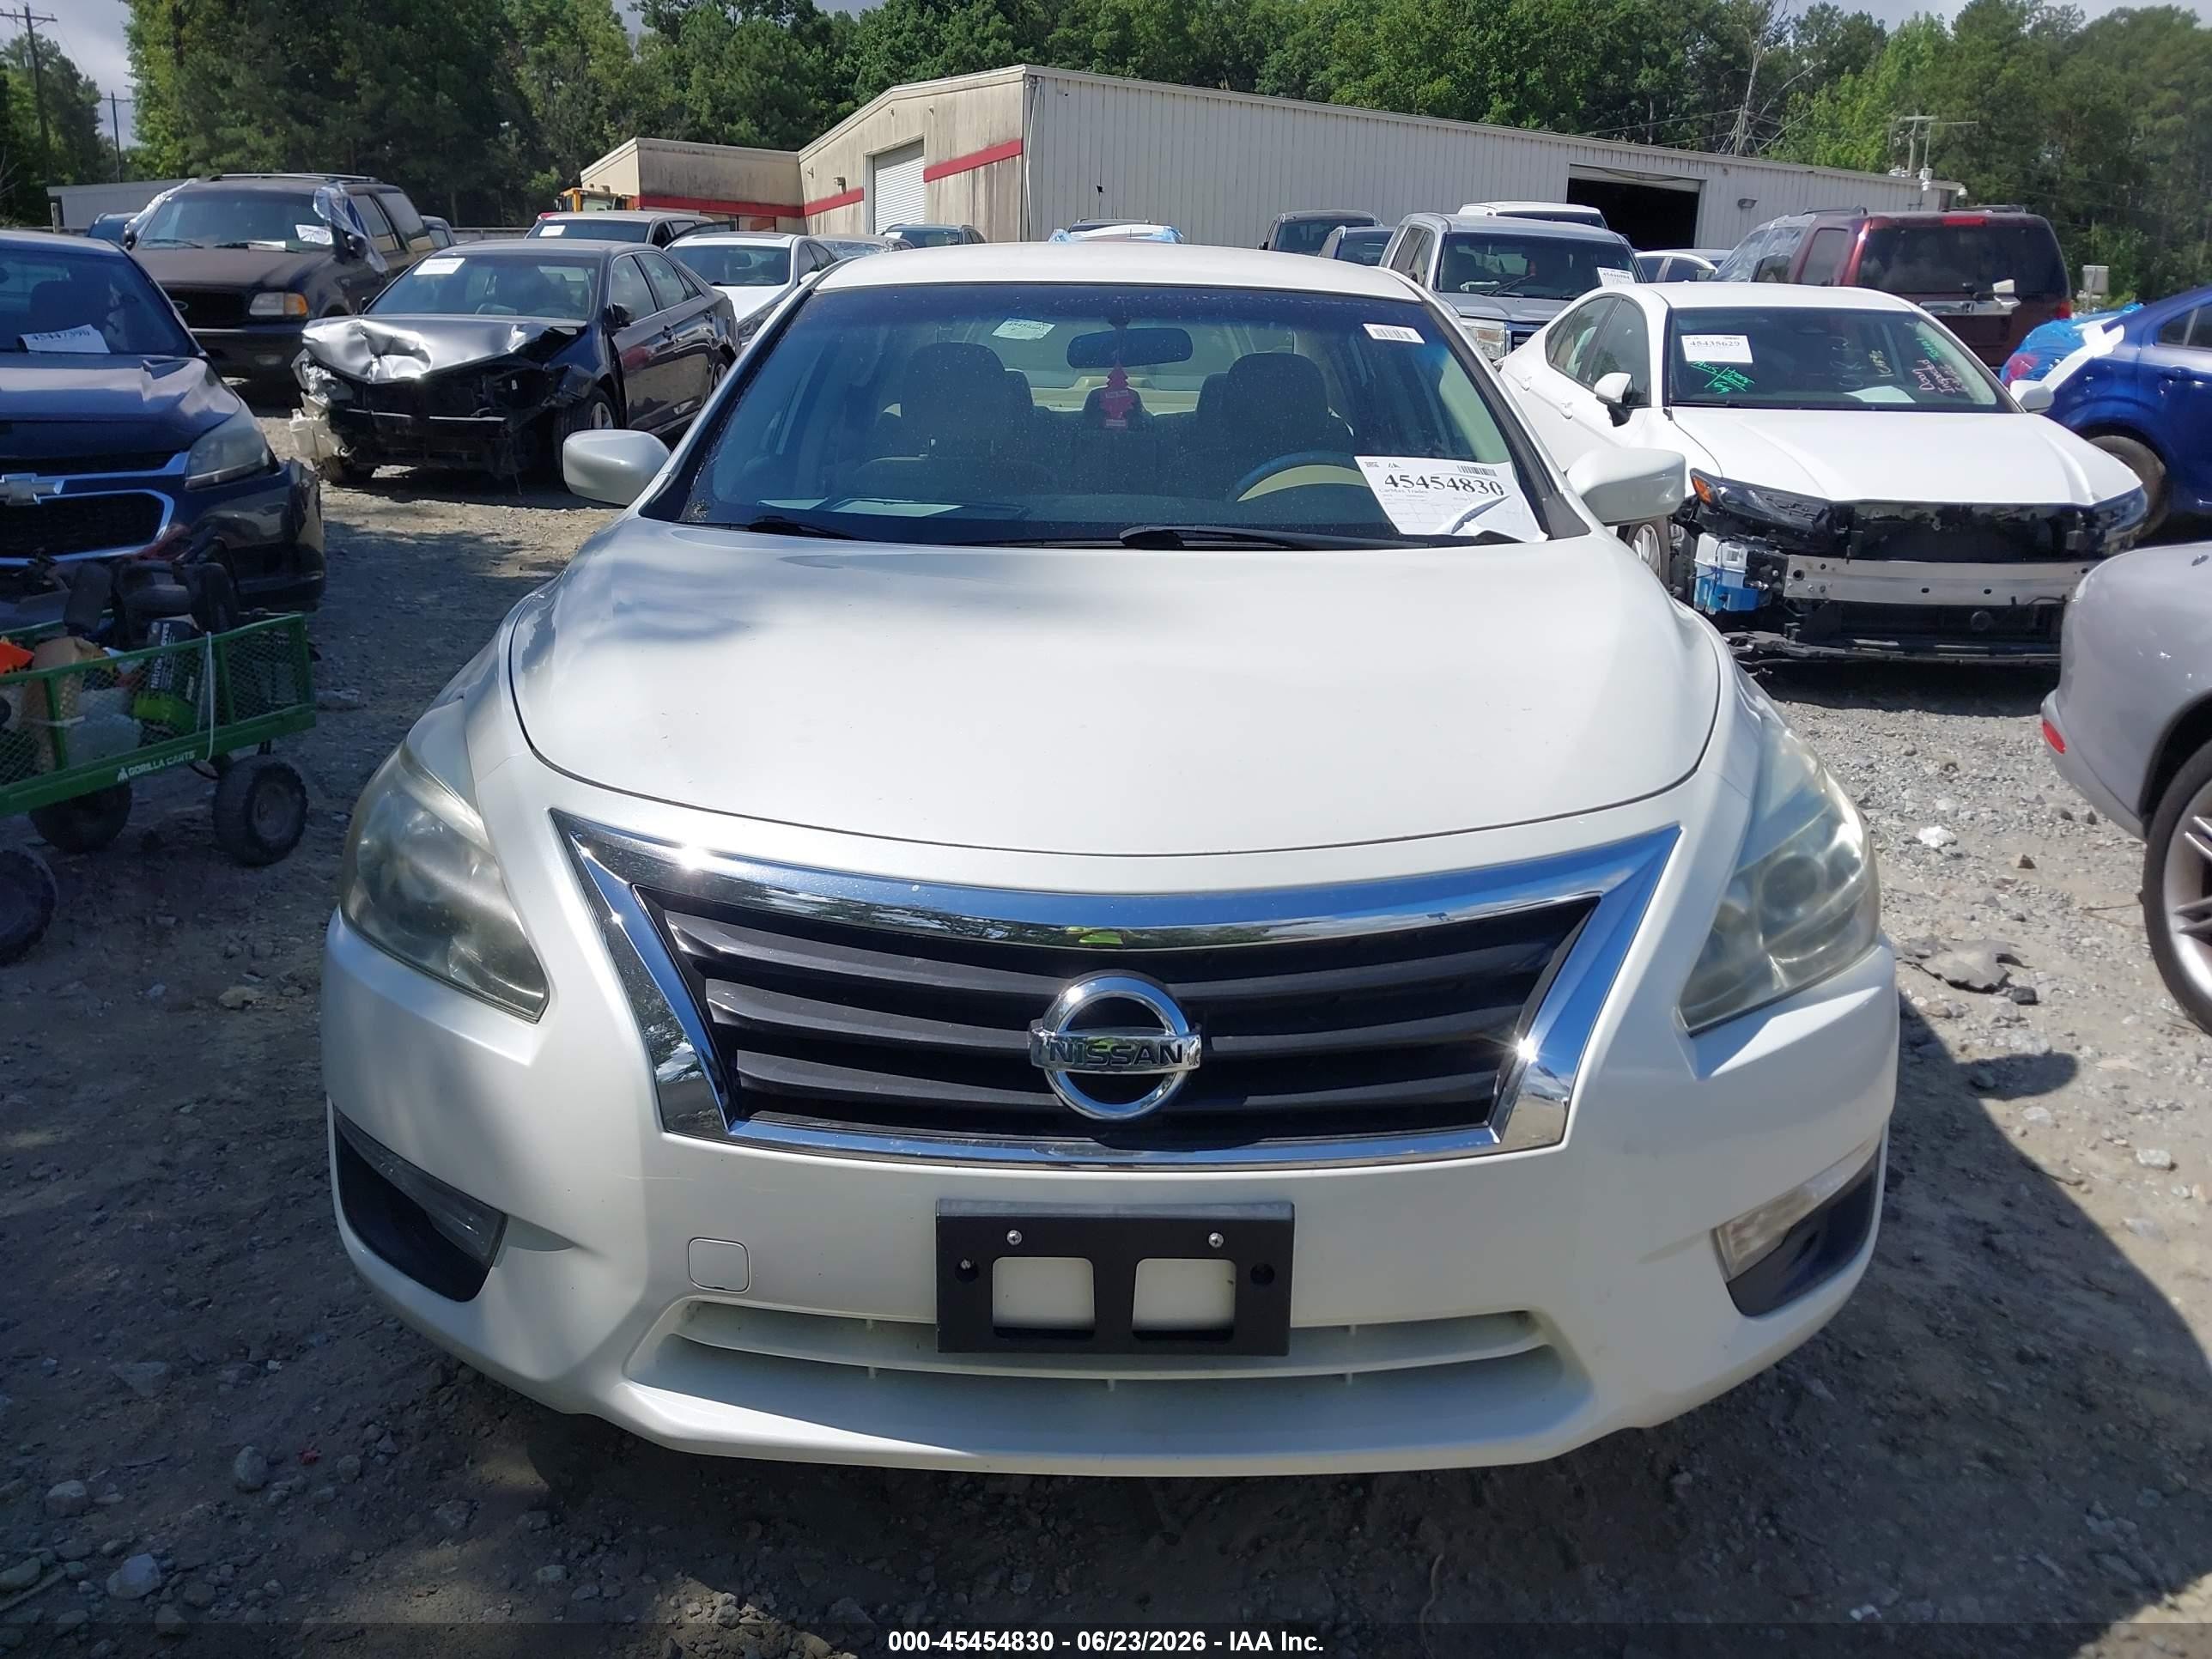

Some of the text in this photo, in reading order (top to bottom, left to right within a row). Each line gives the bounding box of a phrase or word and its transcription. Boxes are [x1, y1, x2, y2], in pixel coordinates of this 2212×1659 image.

[1384, 474, 1504, 496] 45454830
[128, 759, 166, 776] GORILLA
[1049, 1042, 1182, 1066] NISSAN
